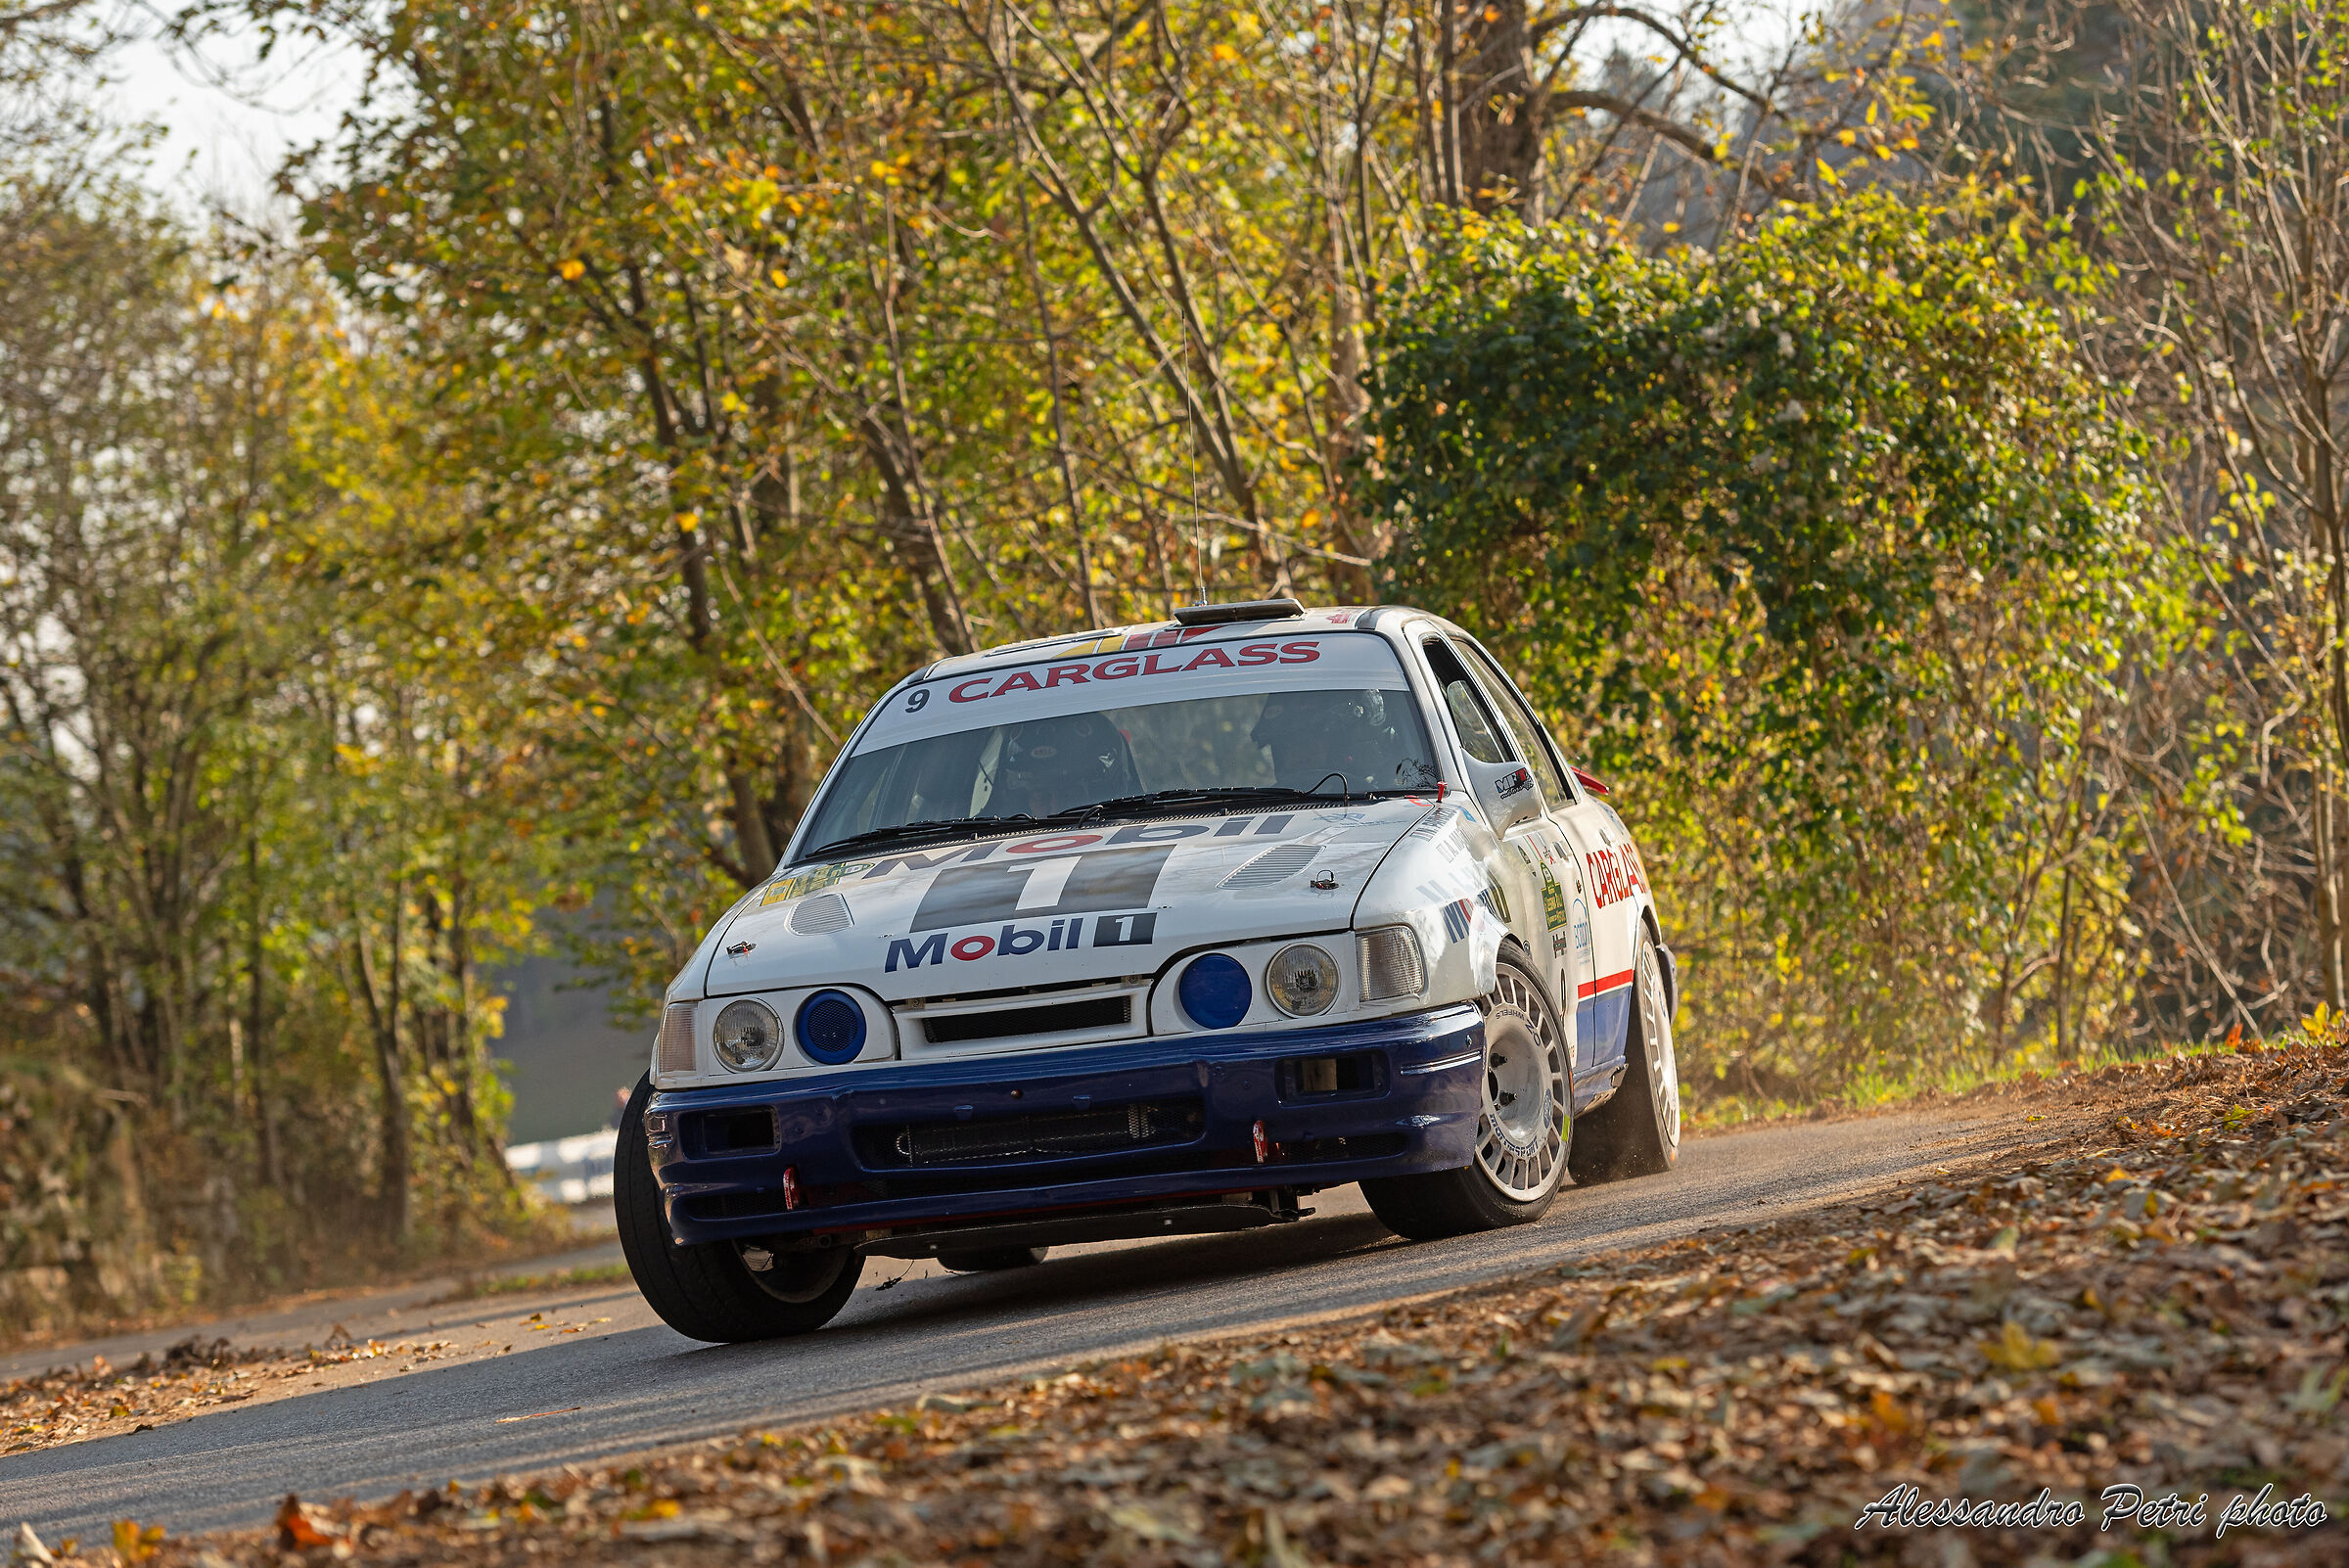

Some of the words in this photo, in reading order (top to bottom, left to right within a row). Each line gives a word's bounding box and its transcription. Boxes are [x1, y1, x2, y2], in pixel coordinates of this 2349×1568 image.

[948, 641, 1320, 704] CARGLASS
[904, 688, 930, 714] 9
[862, 815, 1294, 880] Mobil
[1586, 843, 1647, 908] CARGLA
[1007, 855, 1082, 910] 1
[885, 917, 1083, 973] Mobil
[1114, 916, 1135, 942] 1
[1496, 1008, 1525, 1021] WHEELS
[1525, 1019, 1542, 1047] OZ
